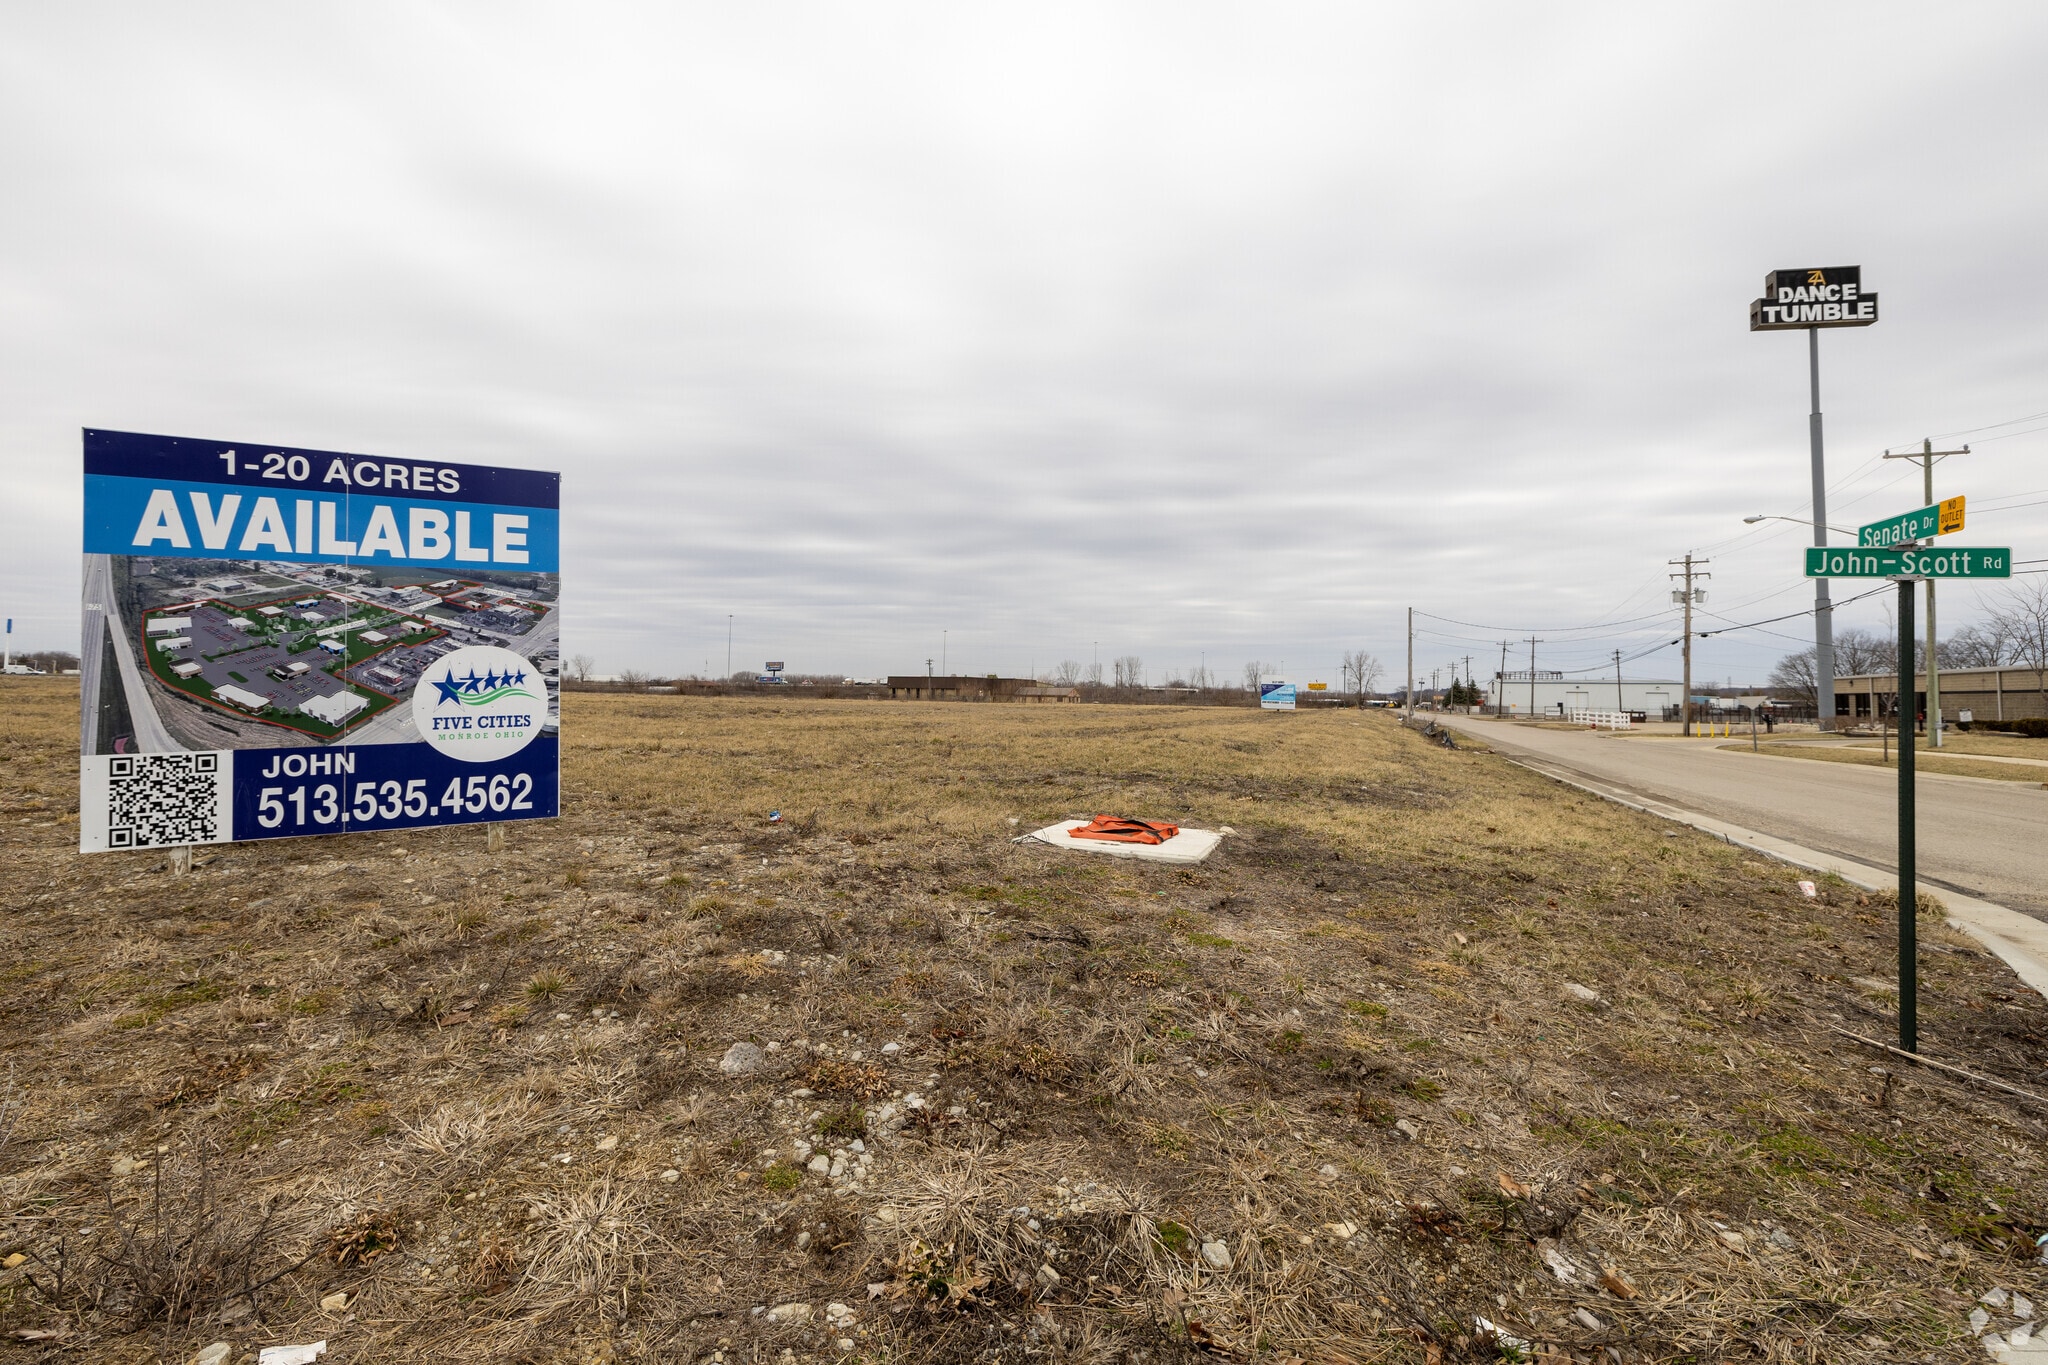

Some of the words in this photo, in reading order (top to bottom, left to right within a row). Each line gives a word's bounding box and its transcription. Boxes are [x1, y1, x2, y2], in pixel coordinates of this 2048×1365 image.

[1778, 283, 1857, 304] DANCE
[1762, 301, 1875, 323] TUMBLE
[219, 449, 311, 482] 1-20
[323, 459, 461, 494] ACRES
[1940, 509, 1963, 524] OUTLET
[1947, 500, 1957, 511] NO
[132, 488, 530, 564] AVAILABLE
[1863, 517, 1918, 547] Senate
[1922, 516, 1934, 529] Dr
[1814, 551, 1972, 575] John-Scott
[1983, 556, 2002, 569] Rd
[432, 716, 473, 731] FIVE
[477, 714, 532, 729] CITIES
[438, 732, 489, 741] MONROE
[495, 731, 524, 739] OHIO
[262, 752, 356, 779] JOHN
[257, 772, 534, 829] 513.535.4562
